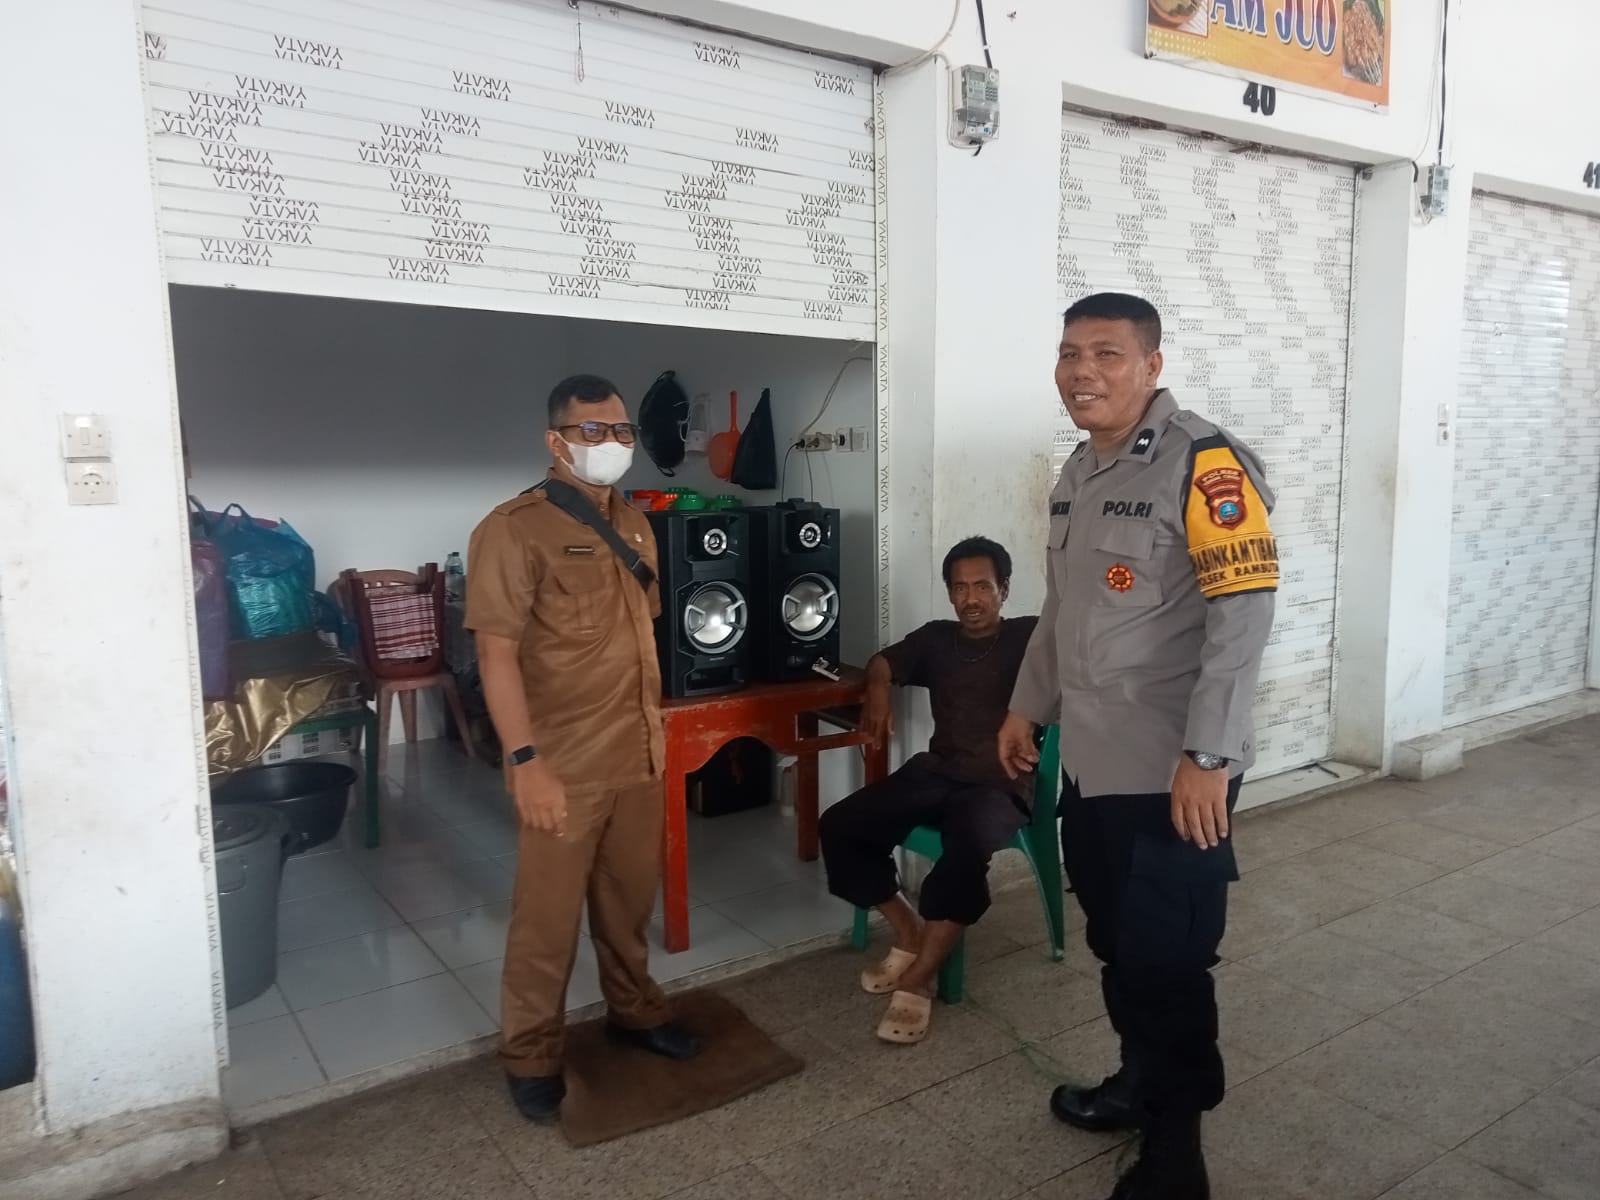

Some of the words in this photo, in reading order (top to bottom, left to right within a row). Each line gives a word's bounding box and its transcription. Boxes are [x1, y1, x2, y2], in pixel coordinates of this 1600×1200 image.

[1243, 81, 1276, 116] 40
[1103, 501, 1152, 518] POLRI
[1199, 571, 1227, 586] OLSEK
